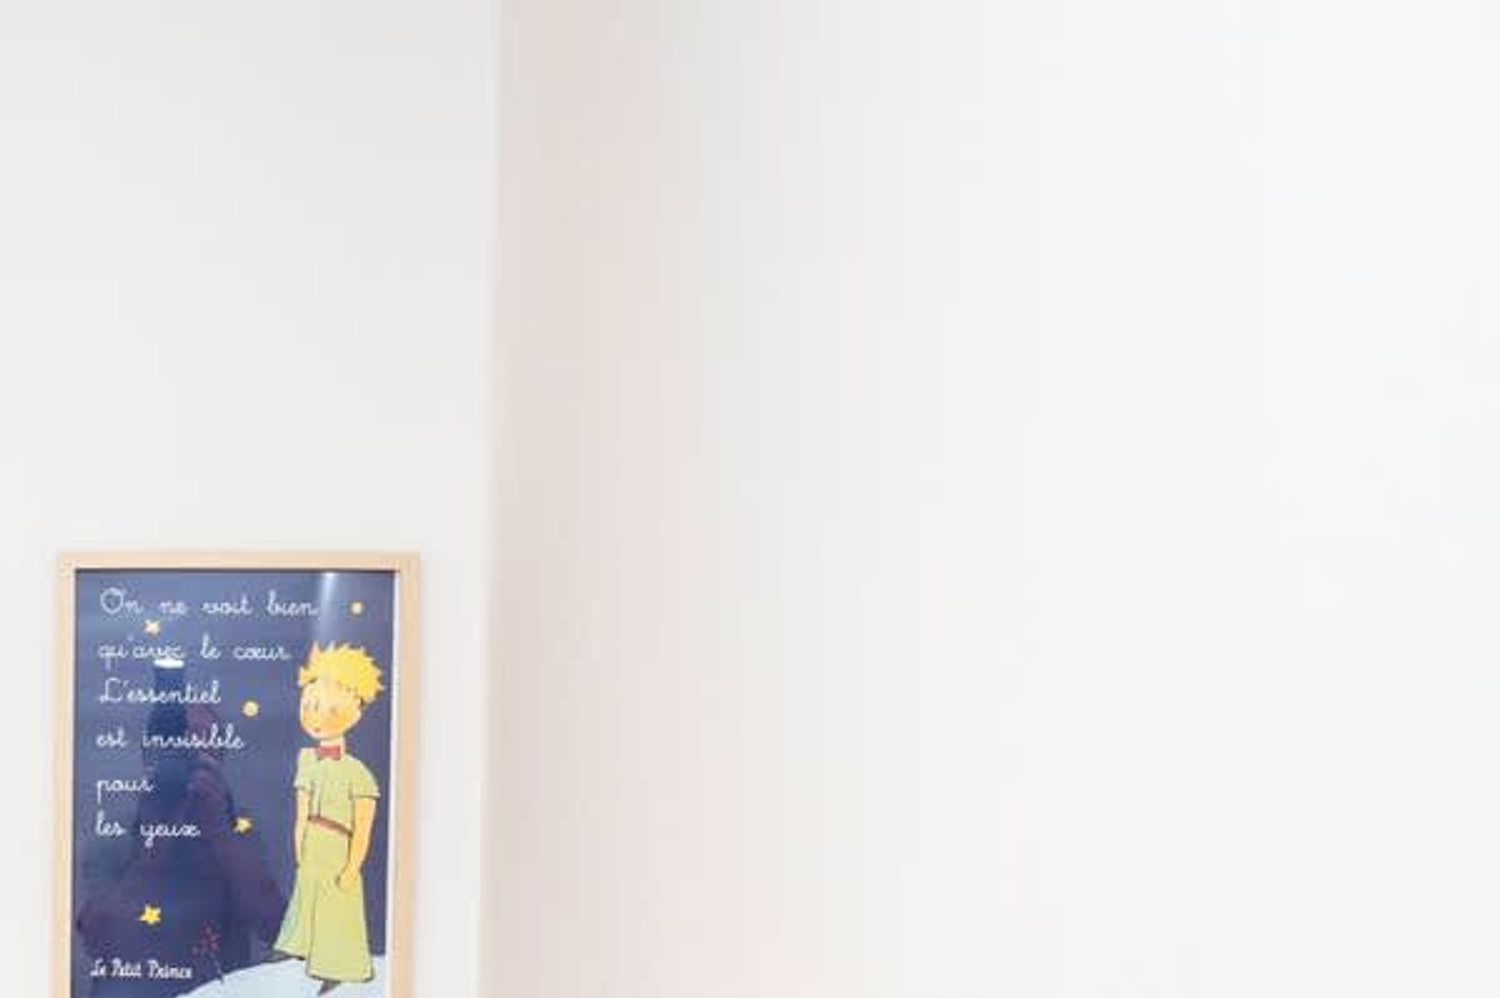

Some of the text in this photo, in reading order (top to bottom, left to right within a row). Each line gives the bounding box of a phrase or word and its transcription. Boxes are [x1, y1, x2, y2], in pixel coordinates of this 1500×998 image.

[100, 587, 319, 615] On ne voit bien
[200, 634, 221, 659] le
[99, 677, 221, 704] L'essentiel
[96, 723, 245, 750] est invisible
[96, 776, 153, 804] pour
[95, 811, 201, 848] les yeux
[90, 957, 193, 979] Le Petit Prince
